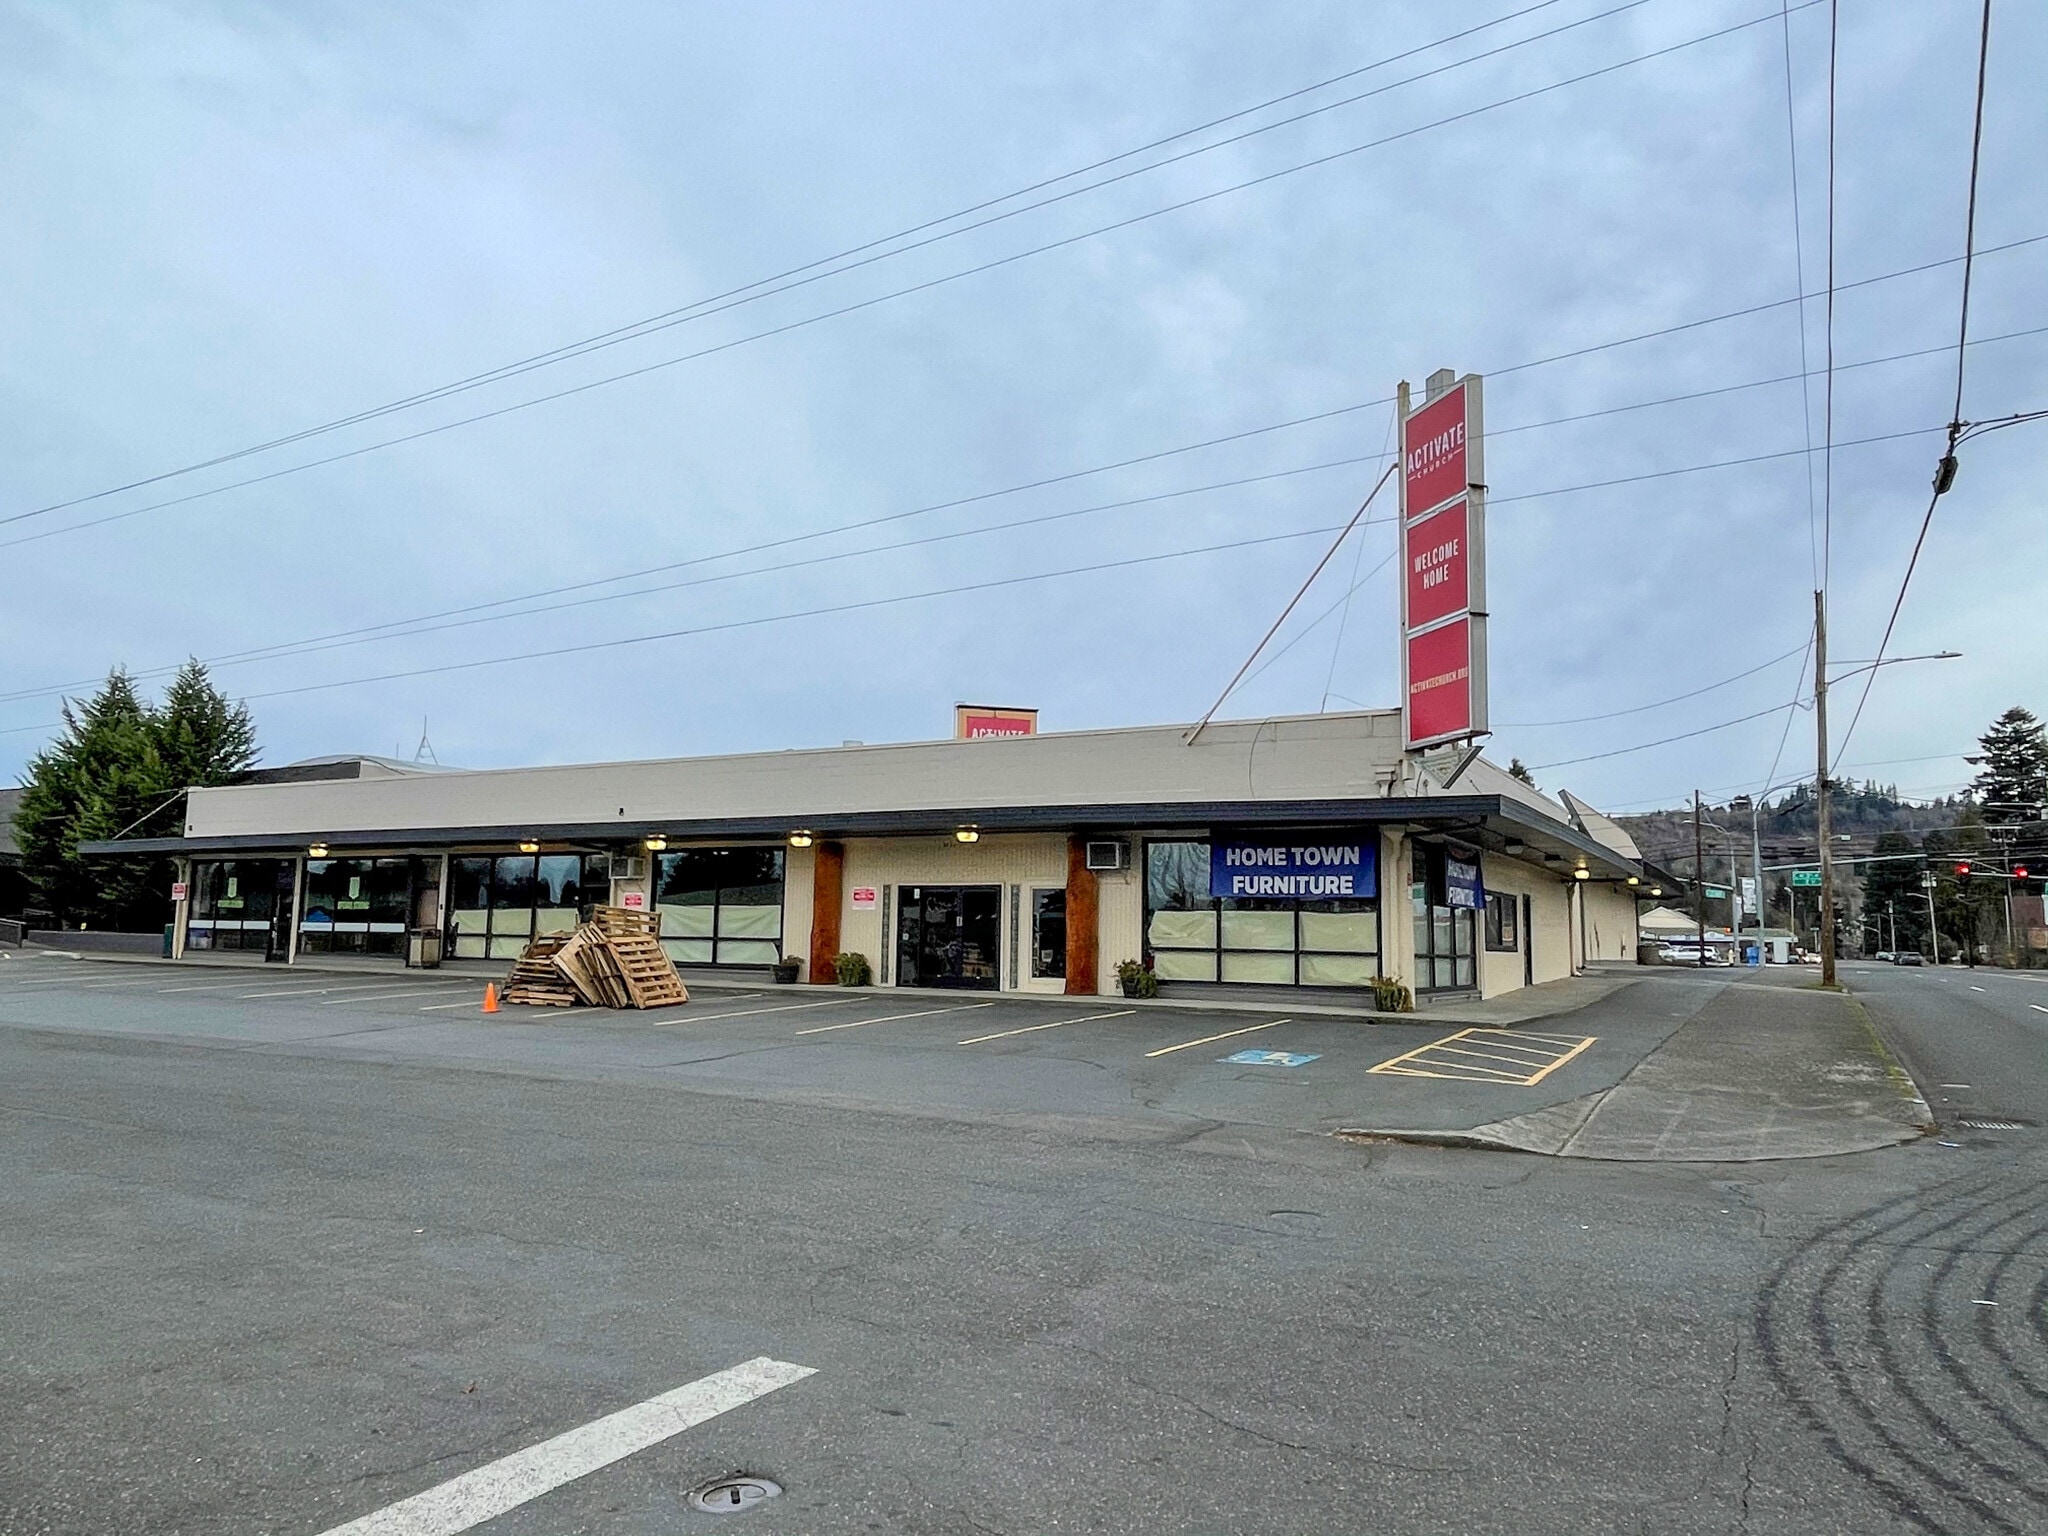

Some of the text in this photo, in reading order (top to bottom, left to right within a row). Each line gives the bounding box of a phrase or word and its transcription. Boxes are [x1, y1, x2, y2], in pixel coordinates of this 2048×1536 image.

[1408, 422, 1464, 474] ACTIVATE
[1417, 453, 1453, 478] CHURCH
[1414, 538, 1459, 573] WELCOME
[1423, 564, 1449, 590] HOME
[1226, 847, 1360, 866] HOME TOWN
[1232, 875, 1354, 894] FURNITURE
